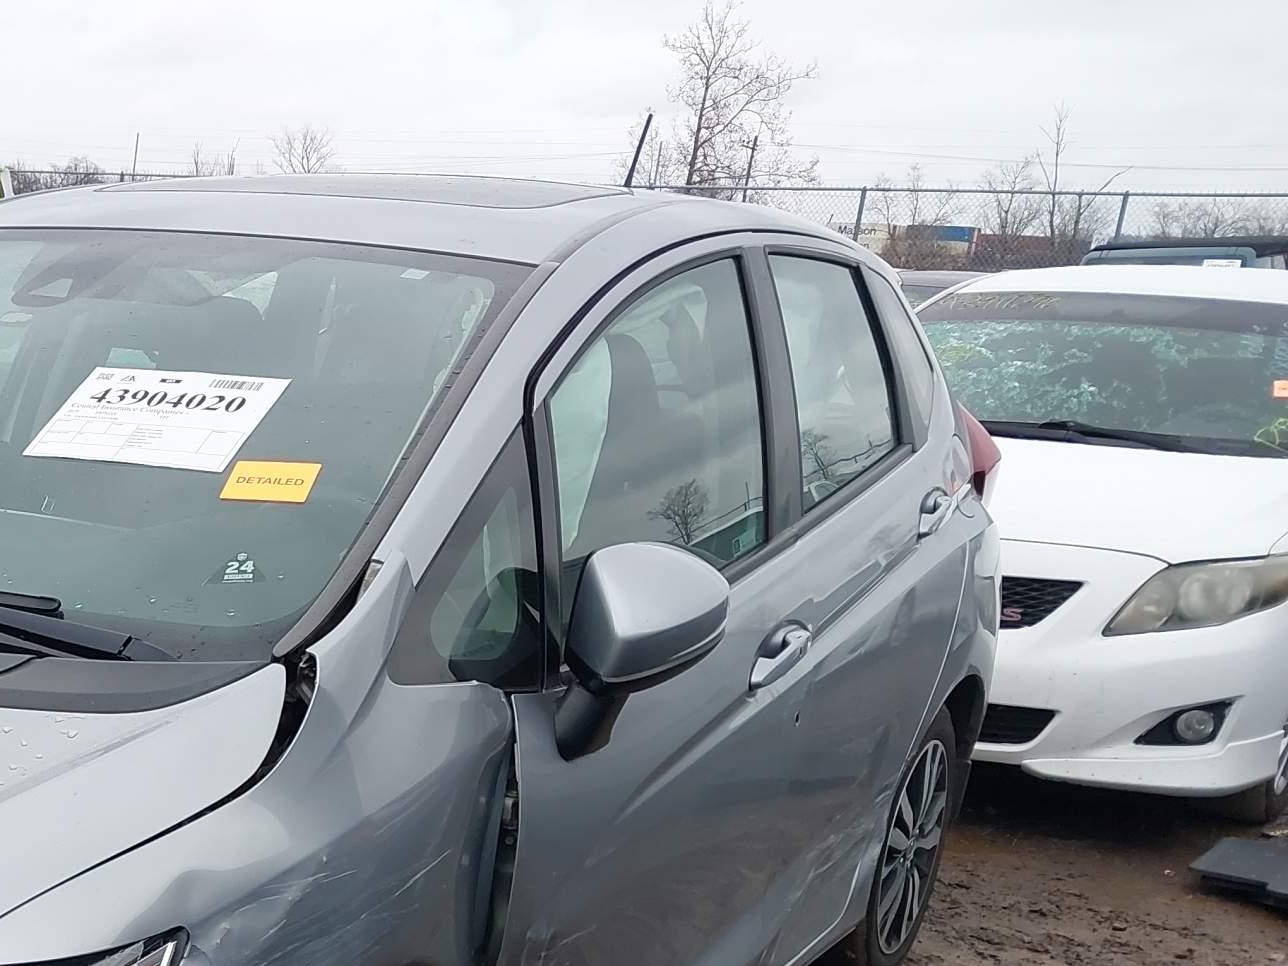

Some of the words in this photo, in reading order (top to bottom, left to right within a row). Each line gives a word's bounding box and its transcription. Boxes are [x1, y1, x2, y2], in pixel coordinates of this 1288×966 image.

[90, 387, 247, 413] 43904020
[236, 476, 304, 486] DETAILED
[225, 560, 255, 574] 24
